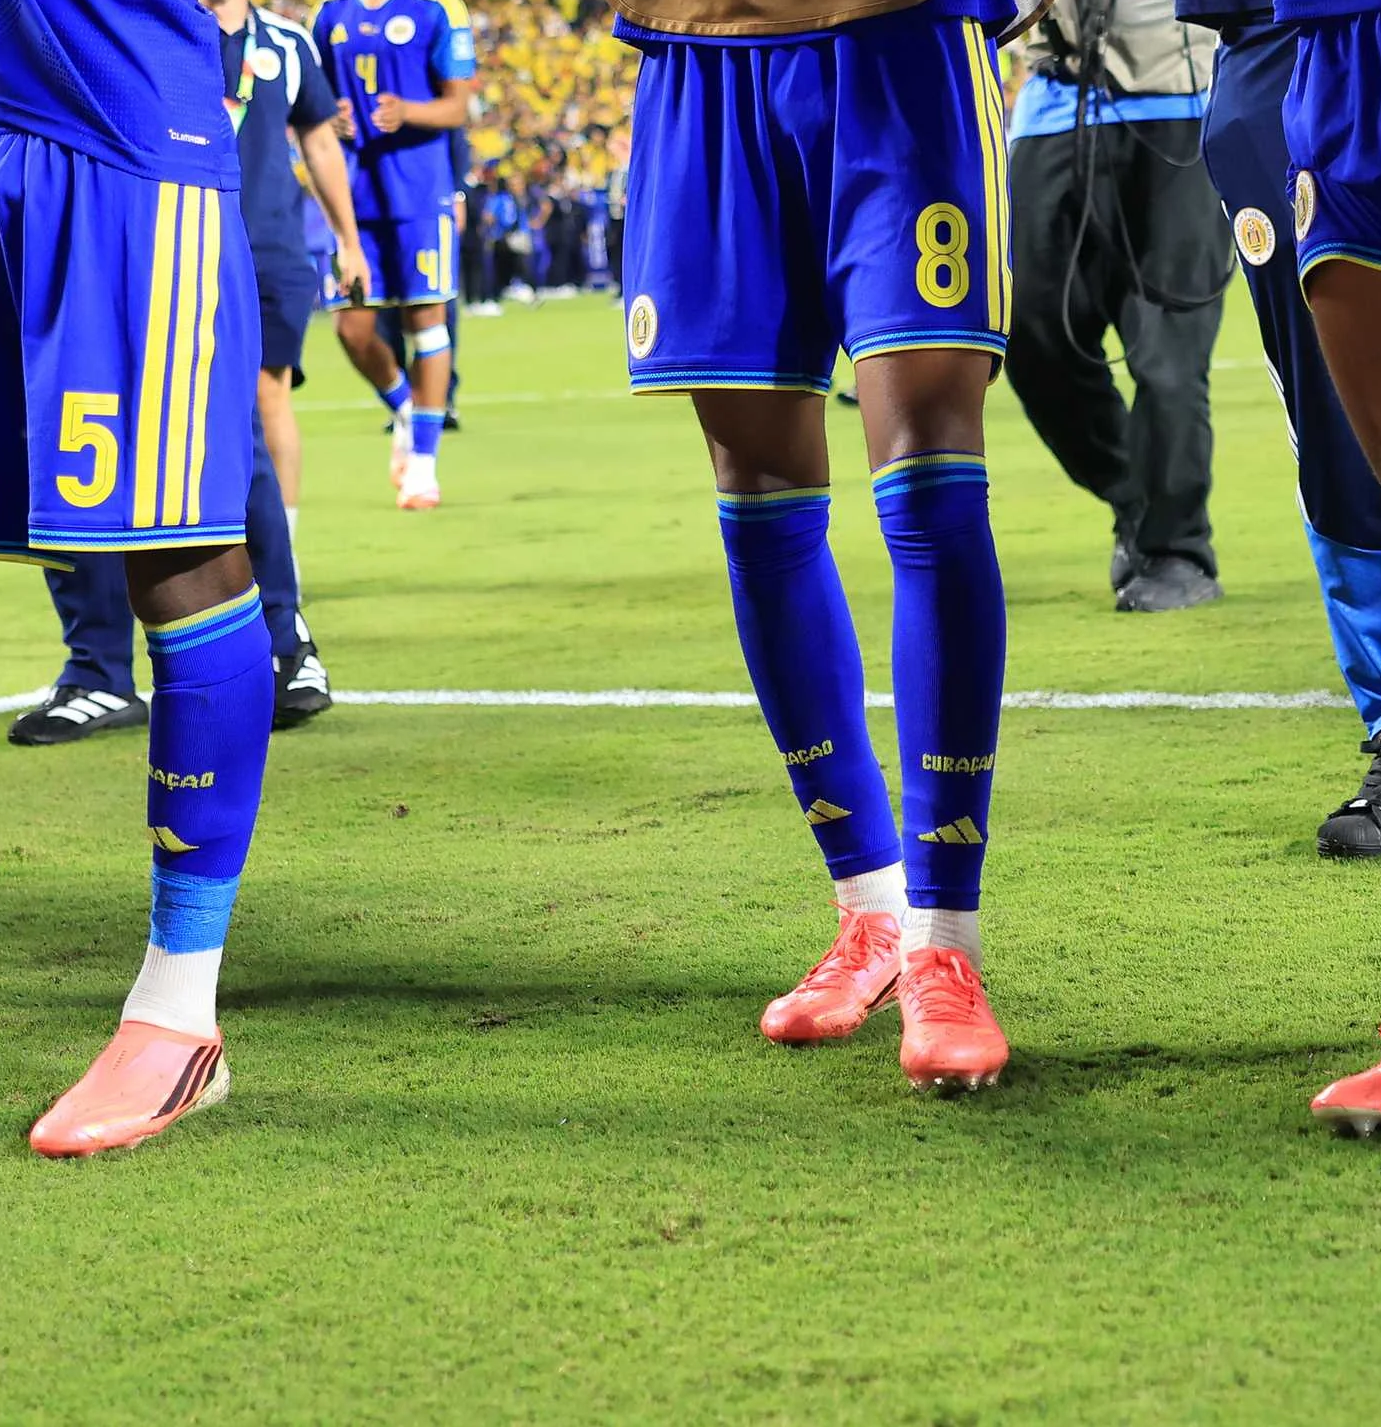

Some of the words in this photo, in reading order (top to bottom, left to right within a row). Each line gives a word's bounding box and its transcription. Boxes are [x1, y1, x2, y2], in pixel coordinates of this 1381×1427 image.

[355, 53, 377, 94] 4
[416, 249, 440, 291] 4
[915, 202, 970, 308] 8
[59, 391, 120, 508] 5
[781, 739, 833, 766] RAÇAO
[149, 763, 215, 791] AÇAO
